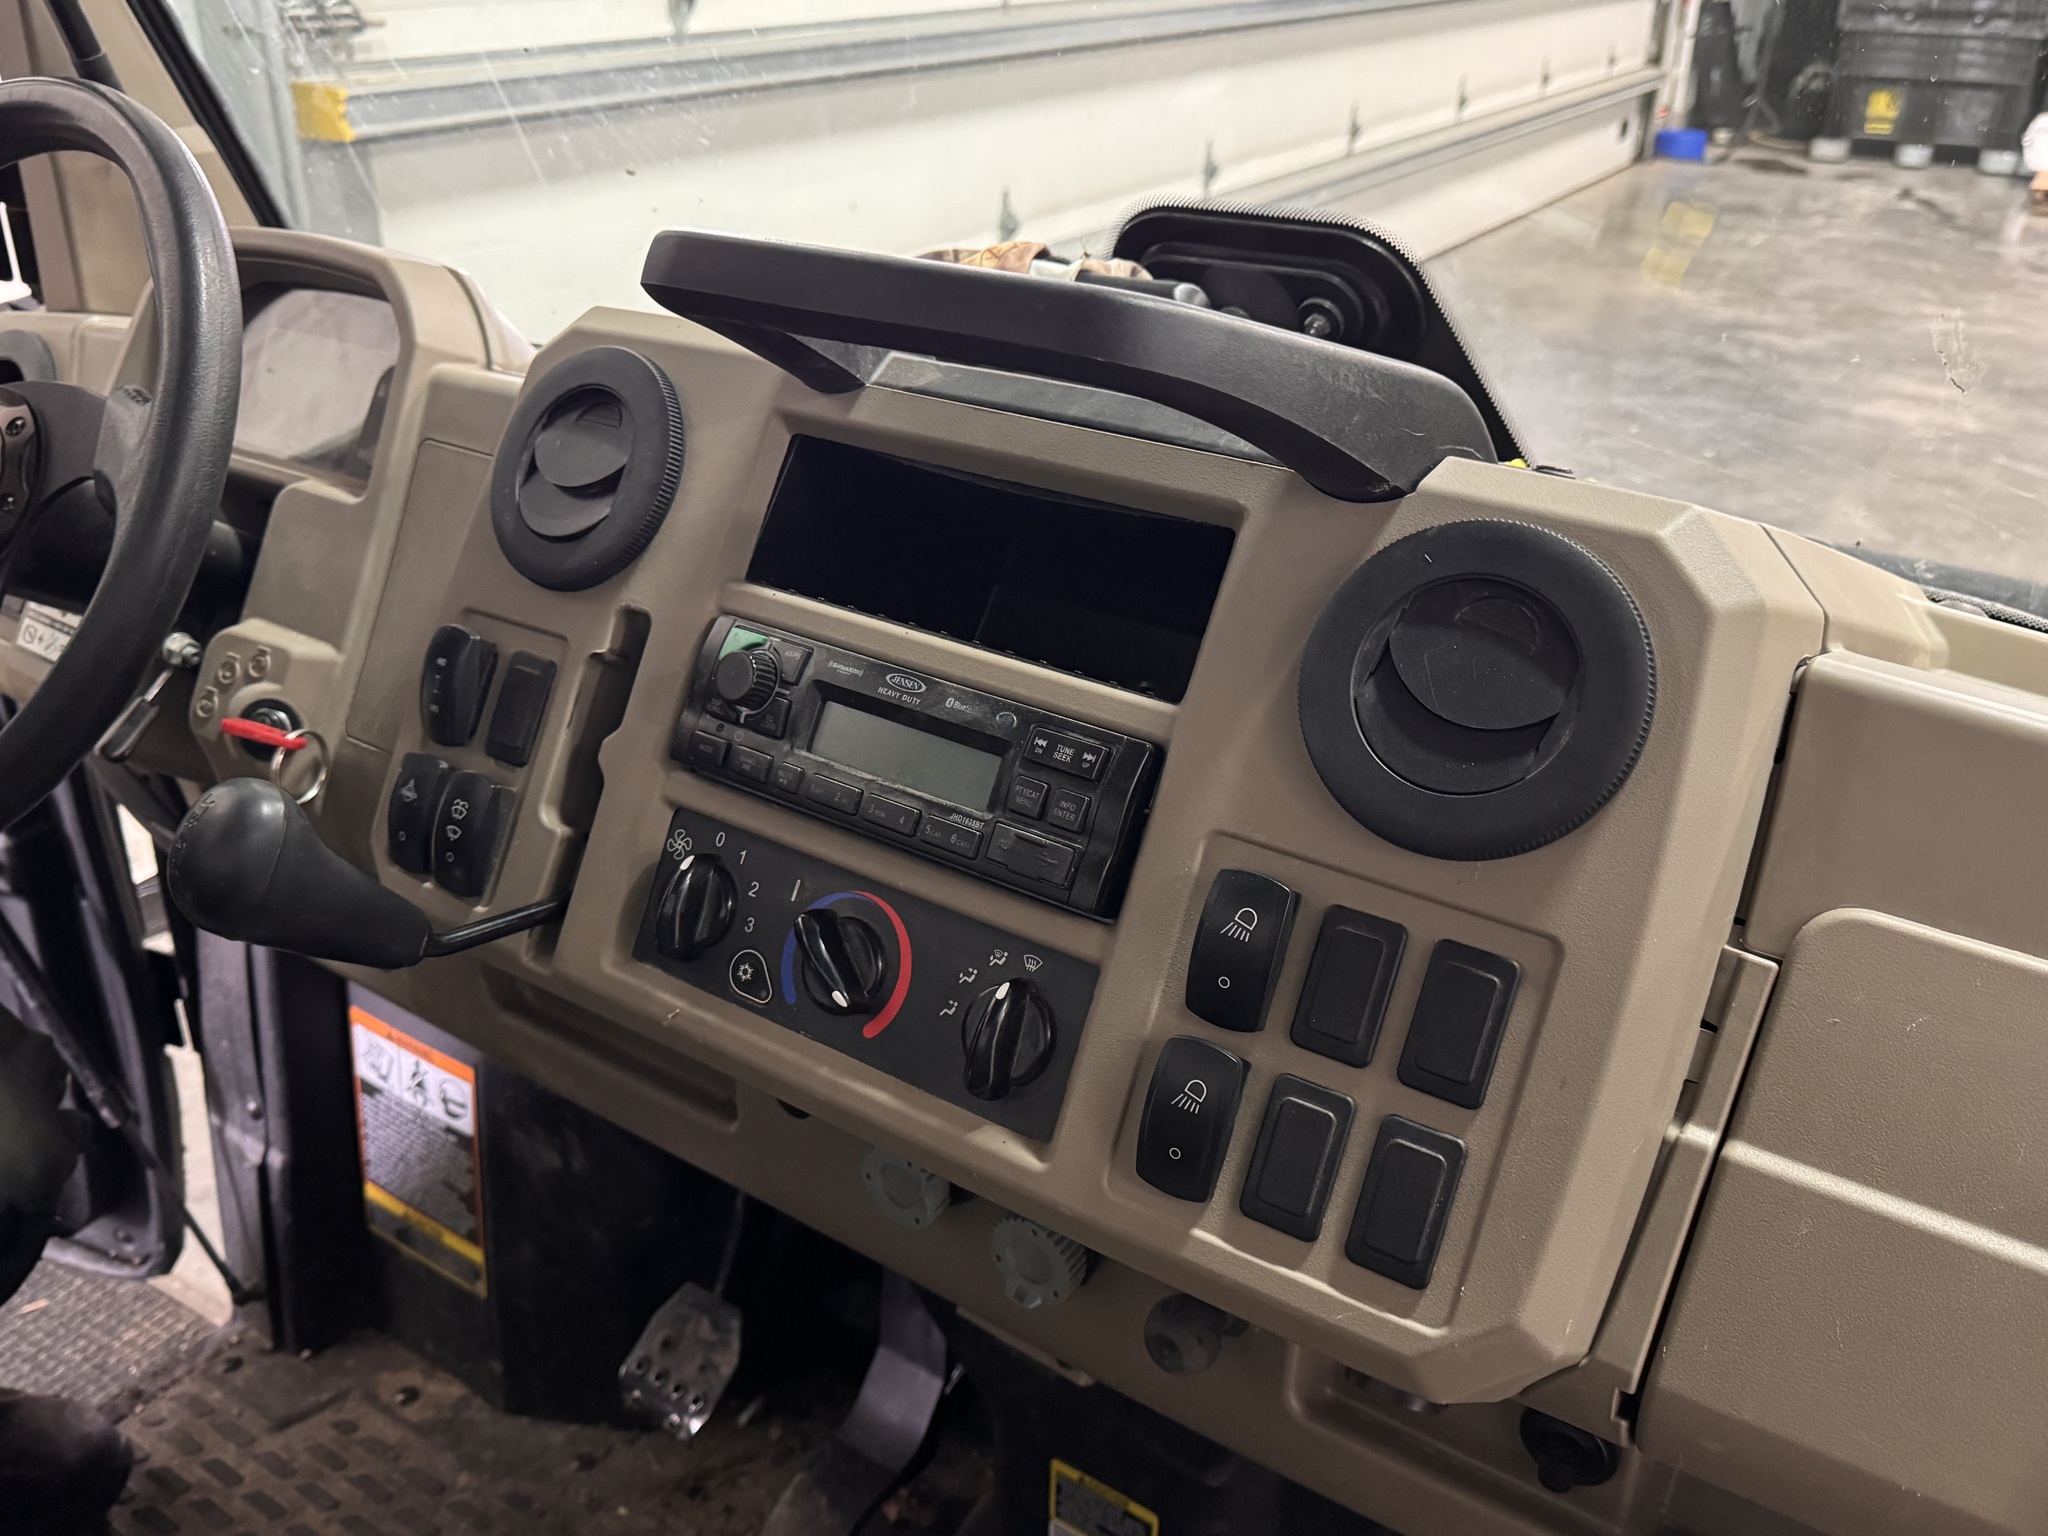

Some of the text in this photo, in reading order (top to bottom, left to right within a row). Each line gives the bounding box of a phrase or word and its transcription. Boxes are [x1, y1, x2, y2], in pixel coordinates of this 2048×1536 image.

[890, 676, 921, 691] JENSEN
[877, 686, 922, 706] HEAVY DUTY
[1052, 751, 1072, 763] SEEK
[1056, 744, 1076, 756] TUNE
[834, 792, 841, 801] 2
[1059, 800, 1077, 812] INFO
[868, 804, 875, 813] 3
[898, 815, 905, 825] 4
[949, 812, 985, 830] JHD1635BT
[1053, 808, 1076, 821] ENTER
[924, 824, 932, 834] 5
[950, 833, 958, 844] 6
[739, 849, 747, 865] 1
[748, 881, 760, 898] 2
[744, 917, 755, 933] 3
